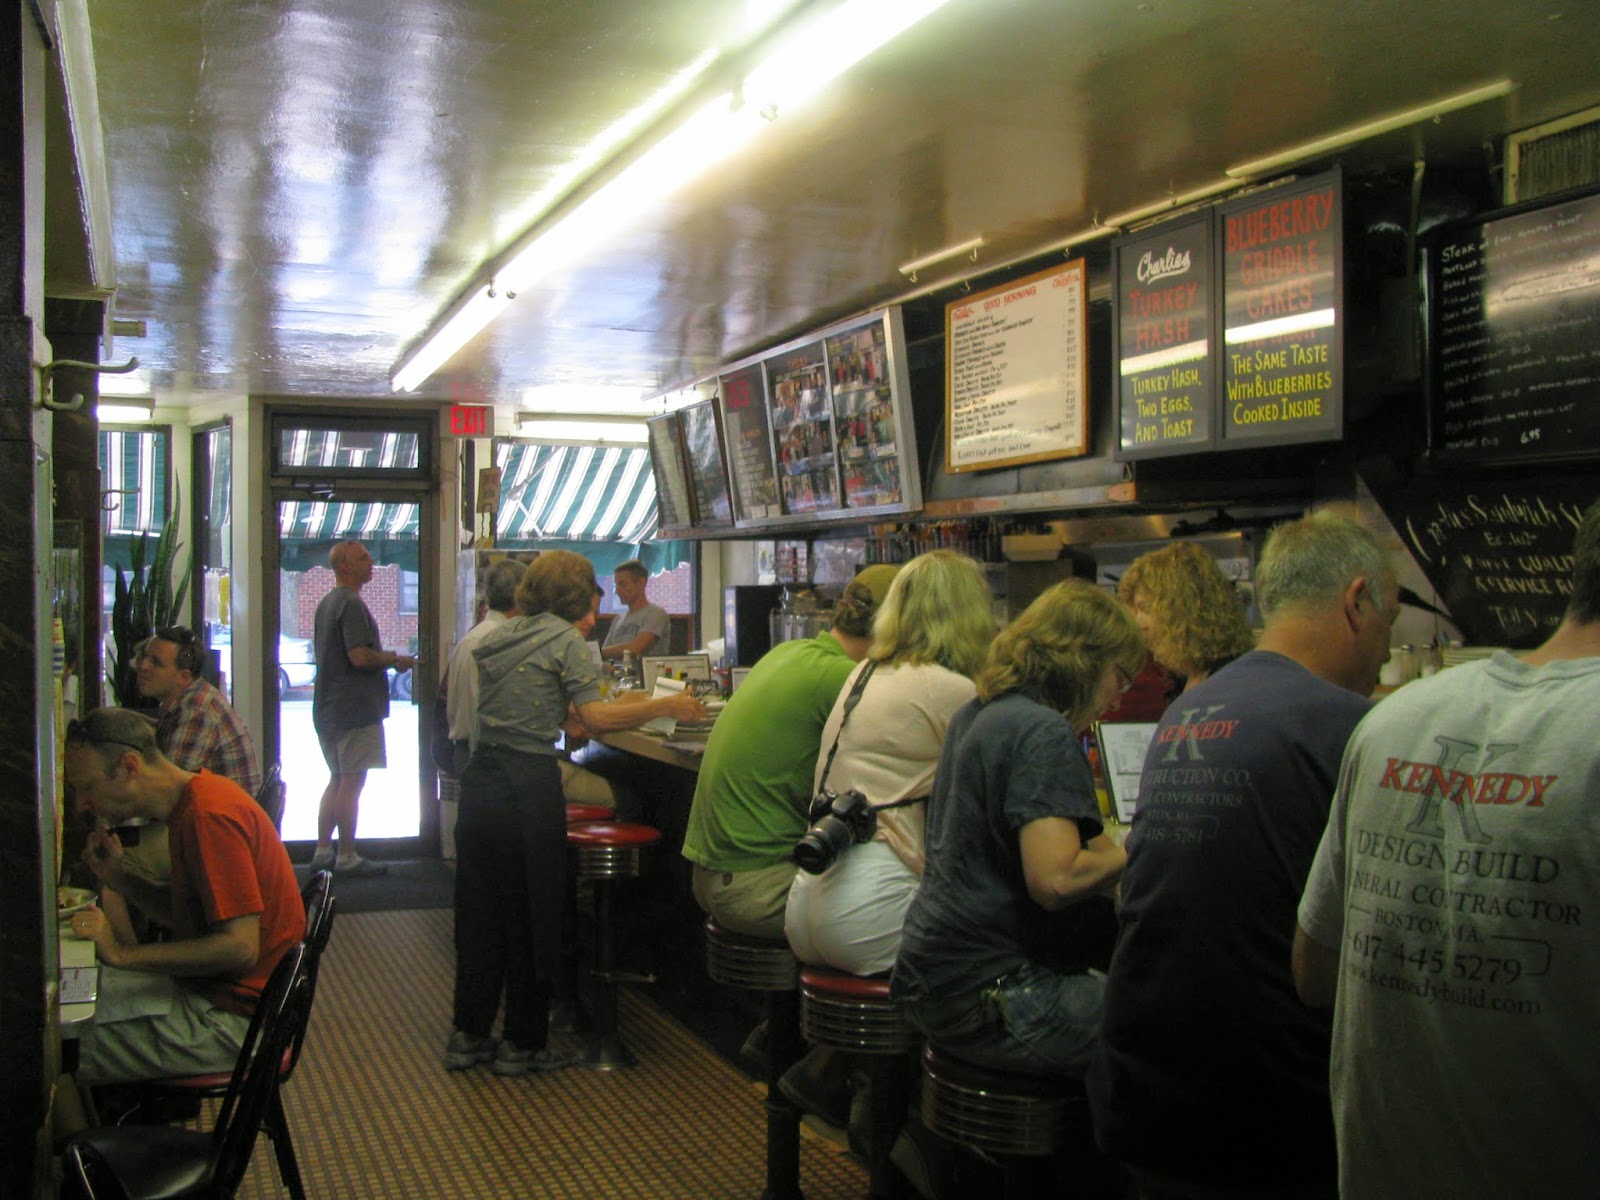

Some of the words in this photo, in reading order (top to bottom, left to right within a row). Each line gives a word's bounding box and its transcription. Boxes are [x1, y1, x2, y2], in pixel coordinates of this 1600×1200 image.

[1227, 191, 1336, 253] BLUEBERRY
[1137, 247, 1190, 285] Charlies
[1240, 240, 1319, 284] GRIDDLE
[1129, 280, 1198, 319] TURKEY
[1246, 280, 1313, 318] CAKES
[1136, 319, 1189, 350] HASH
[1232, 354, 1252, 374] THE
[1255, 349, 1287, 370] SAME
[1290, 344, 1328, 365] TASTE
[1132, 373, 1169, 396] TURKEY
[1227, 380, 1255, 401] WITH
[1255, 371, 1332, 396] BLUEBERRIES
[451, 405, 487, 435] EXIT
[1234, 403, 1279, 425] COOKED
[1281, 398, 1321, 420] INSIDE
[1136, 422, 1158, 444] AND
[1161, 418, 1193, 439] TOAST
[1518, 554, 1575, 575] QUALIT
[1157, 720, 1240, 744] KENNEDY
[1378, 757, 1558, 807] KENNEDY
[1357, 829, 1447, 875] DESIGN
[1451, 849, 1559, 885] BUILD
[1411, 884, 1582, 926] COTRACTOR
